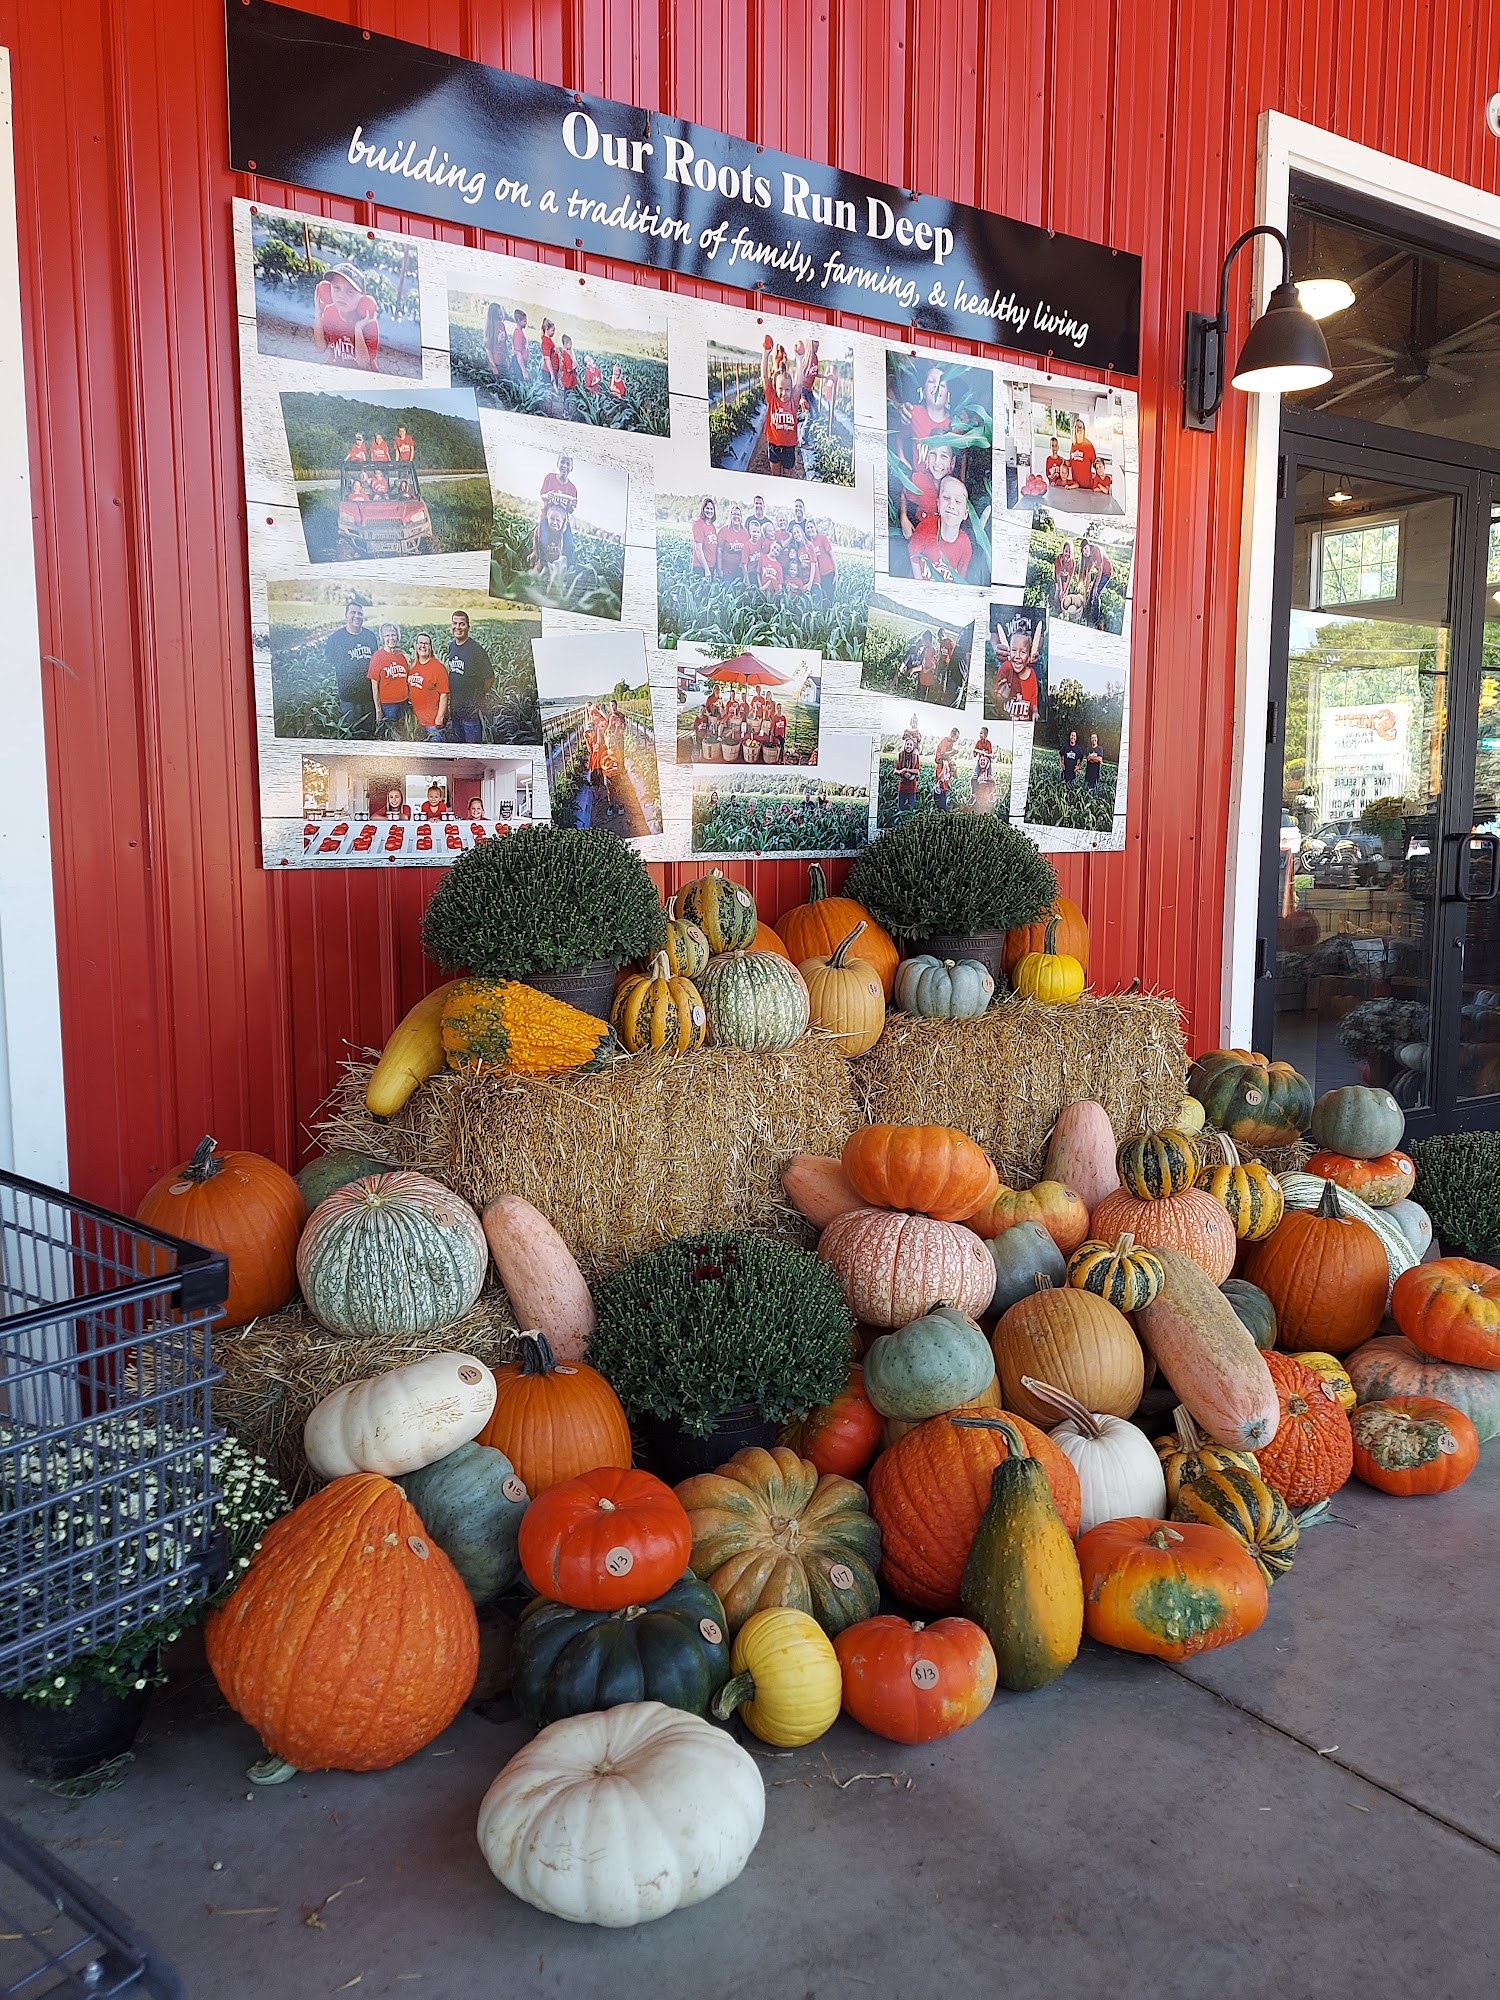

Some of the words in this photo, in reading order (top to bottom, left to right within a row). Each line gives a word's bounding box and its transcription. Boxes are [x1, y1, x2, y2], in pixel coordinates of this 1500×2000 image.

[562, 111, 653, 174] Our
[663, 135, 771, 209] Roots
[781, 171, 857, 232] Run
[866, 196, 954, 265] Deep
[348, 126, 486, 204] building
[495, 177, 531, 207] on
[539, 189, 558, 213] a
[567, 189, 692, 245] tradition
[700, 221, 727, 259] of
[730, 227, 815, 282] family,
[821, 251, 920, 307] farming,
[928, 280, 948, 308] &
[953, 280, 1030, 333] healthy
[1034, 301, 1089, 348] living
[461, 1369, 477, 1381] $13
[1440, 1436, 1455, 1448] $13
[508, 1480, 523, 1496] $15
[609, 1555, 628, 1572] $13
[832, 1570, 850, 1583] $17
[703, 1624, 717, 1637] $15
[915, 1667, 936, 1680] $13
